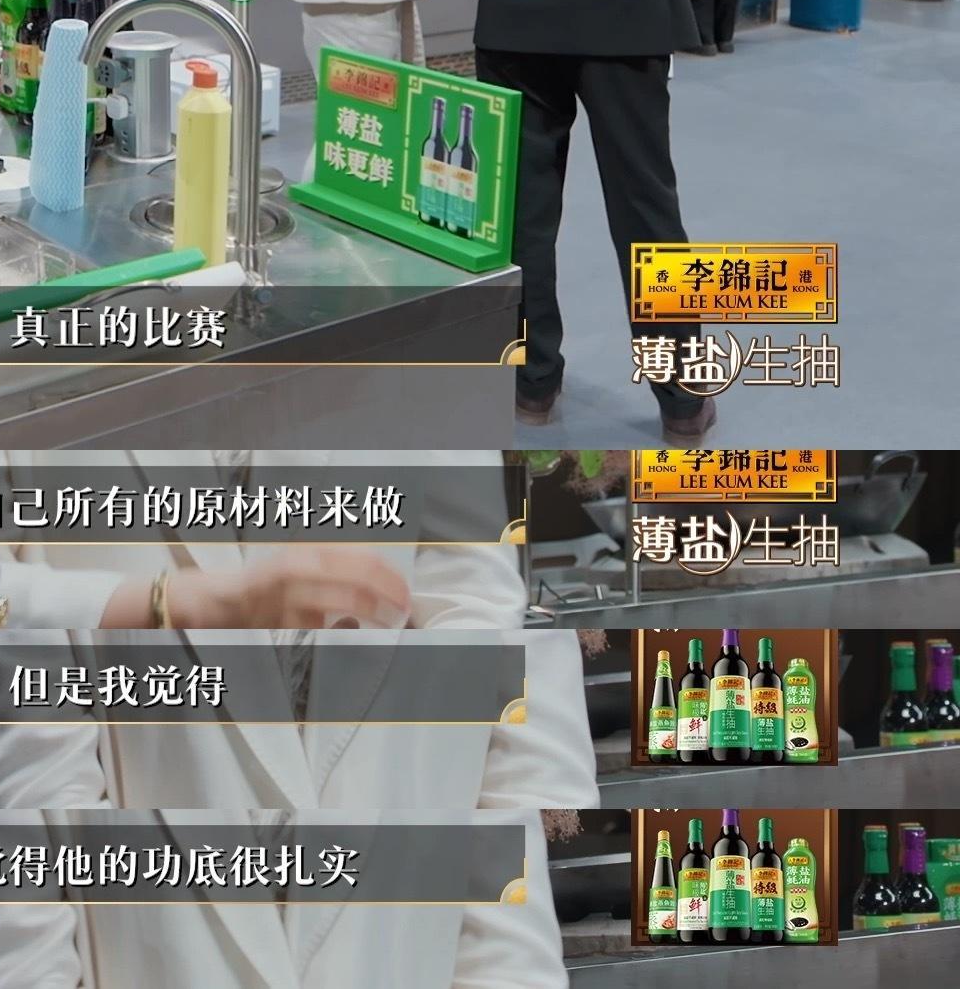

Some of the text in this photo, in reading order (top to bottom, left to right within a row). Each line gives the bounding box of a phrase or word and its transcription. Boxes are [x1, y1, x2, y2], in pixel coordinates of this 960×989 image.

[337, 106, 383, 147] 薄盐
[324, 141, 395, 188] 味更鲜
